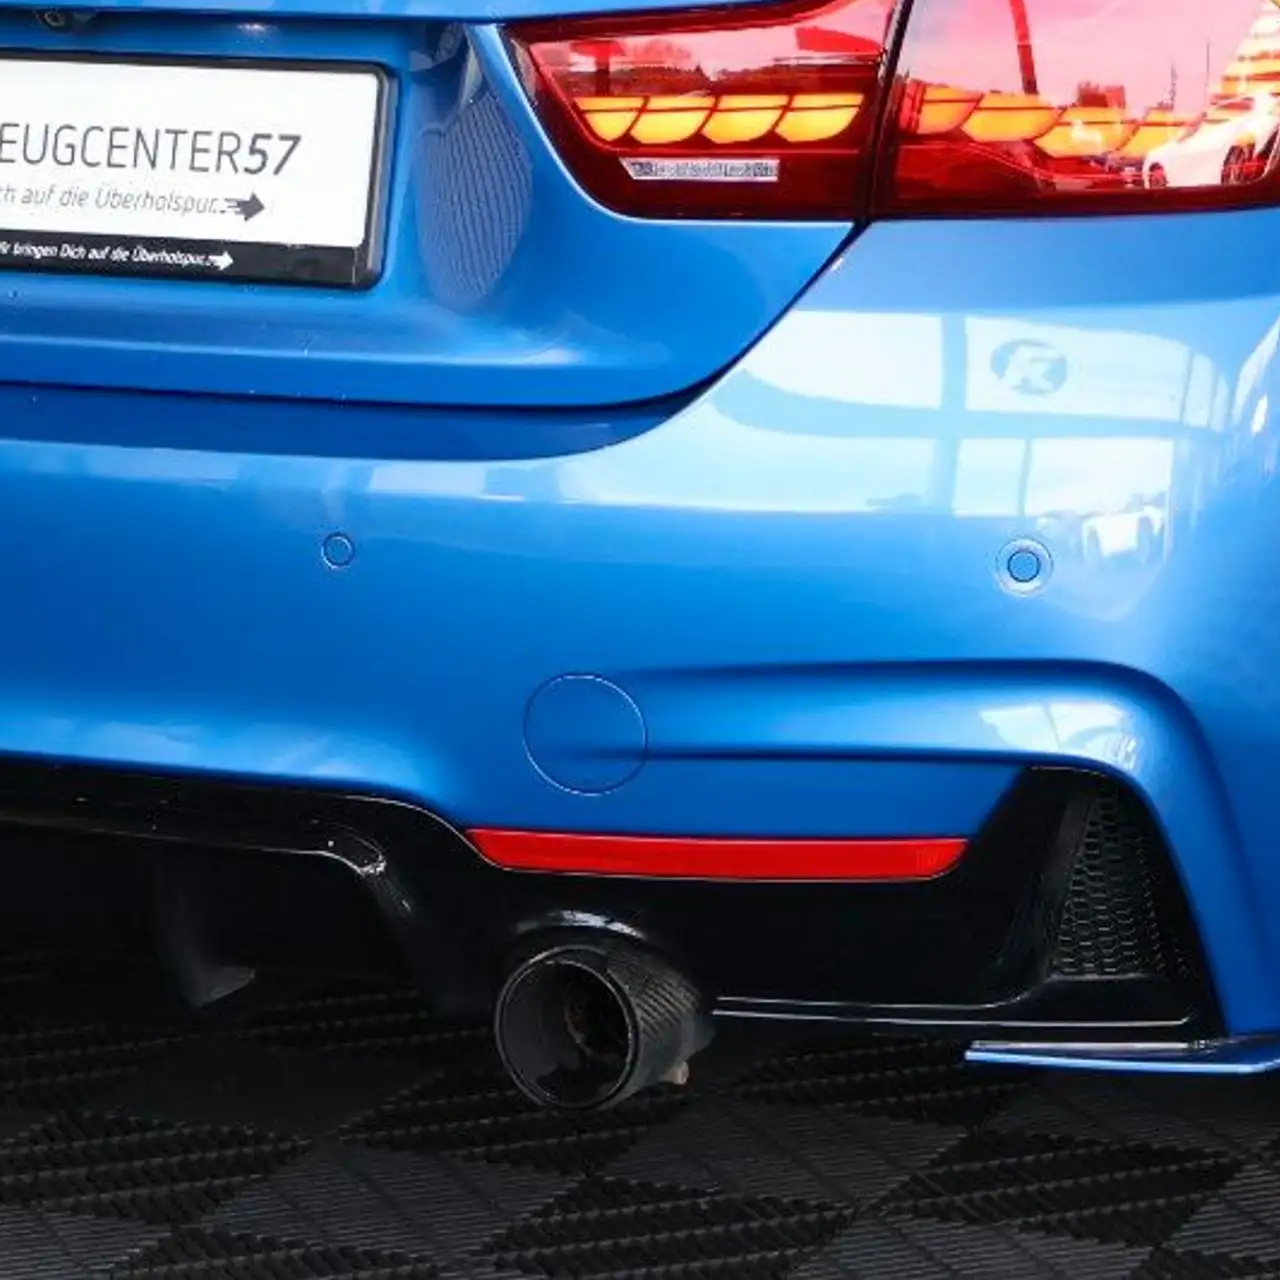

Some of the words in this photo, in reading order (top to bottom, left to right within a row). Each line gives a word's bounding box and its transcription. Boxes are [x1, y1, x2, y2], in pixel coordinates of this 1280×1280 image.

[21, 184, 56, 206] auf
[59, 185, 90, 208] die
[13, 241, 58, 260] bringen
[59, 243, 87, 260] Dich
[88, 245, 110, 260] auf
